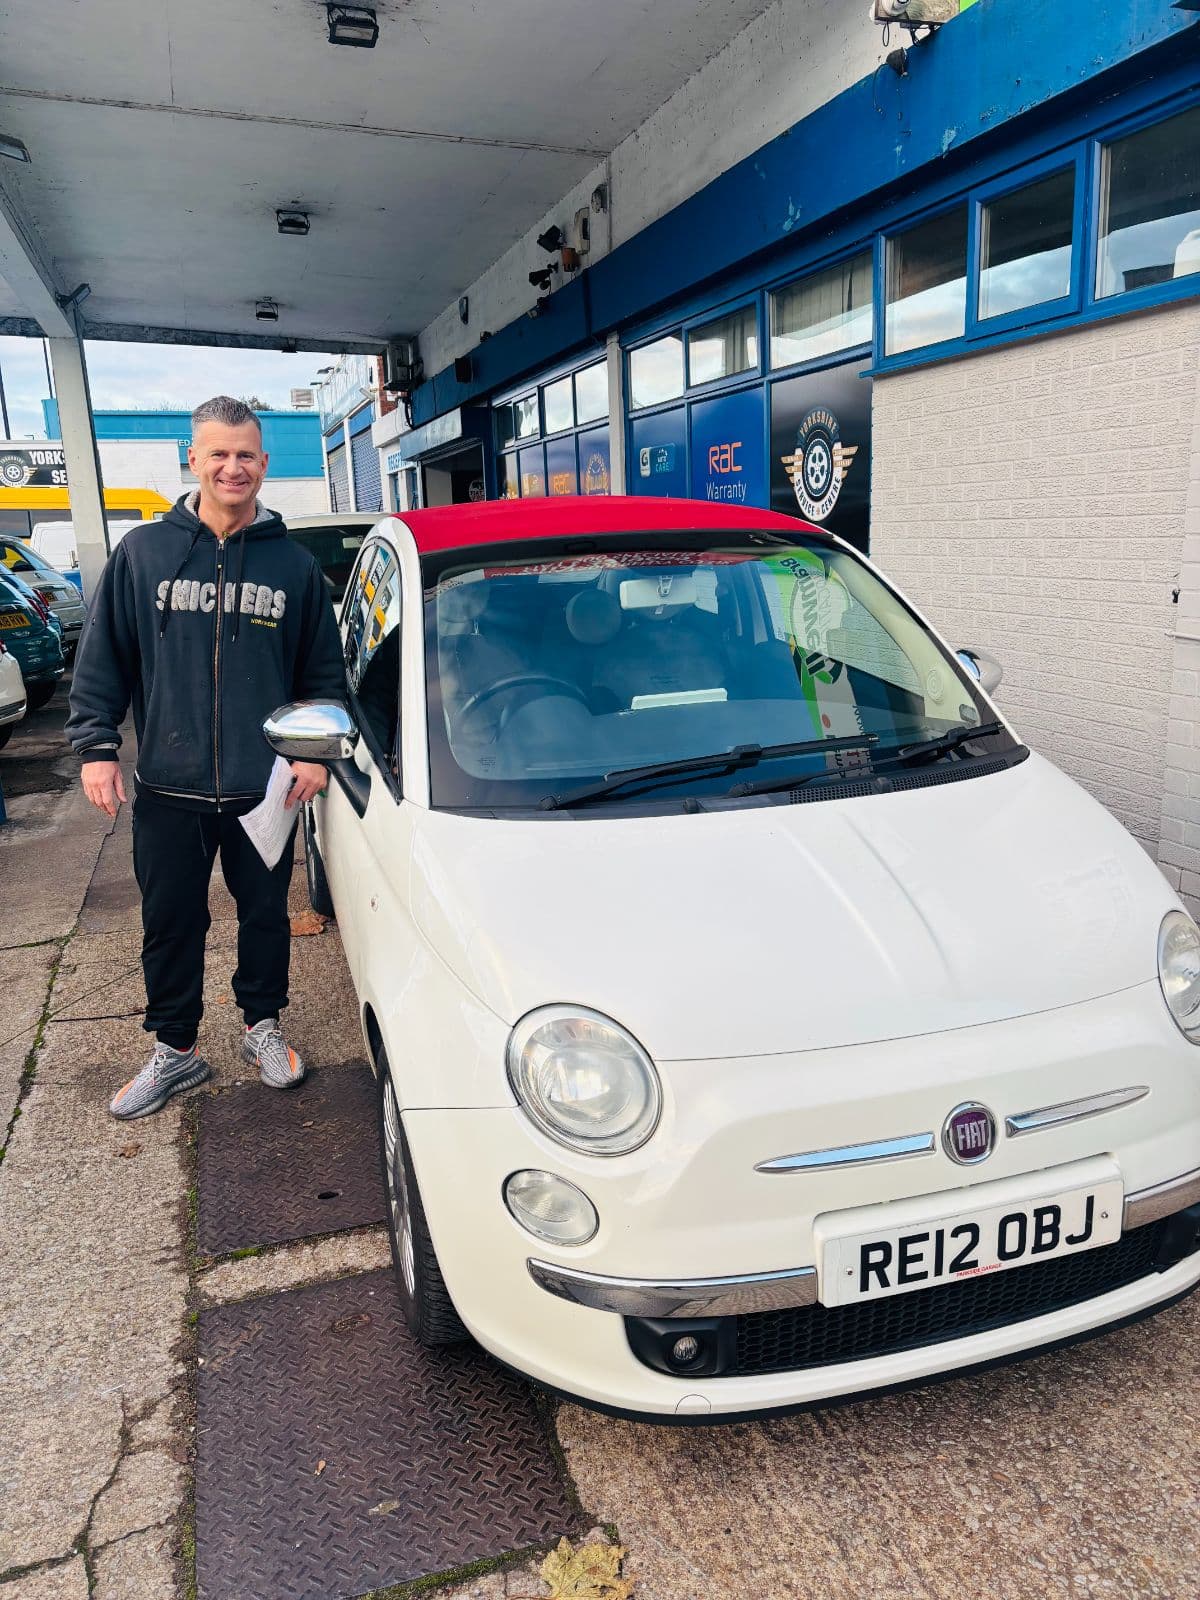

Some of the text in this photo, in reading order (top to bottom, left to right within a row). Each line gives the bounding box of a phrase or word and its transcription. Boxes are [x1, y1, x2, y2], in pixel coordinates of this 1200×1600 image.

[799, 410, 837, 437] YORKSHIRE
[29, 450, 66, 465] YORK
[706, 480, 747, 502] Warranty
[795, 476, 841, 517] SERVICE CENTRE
[956, 1118, 988, 1150] FIAT
[858, 1222, 981, 1293] RE12
